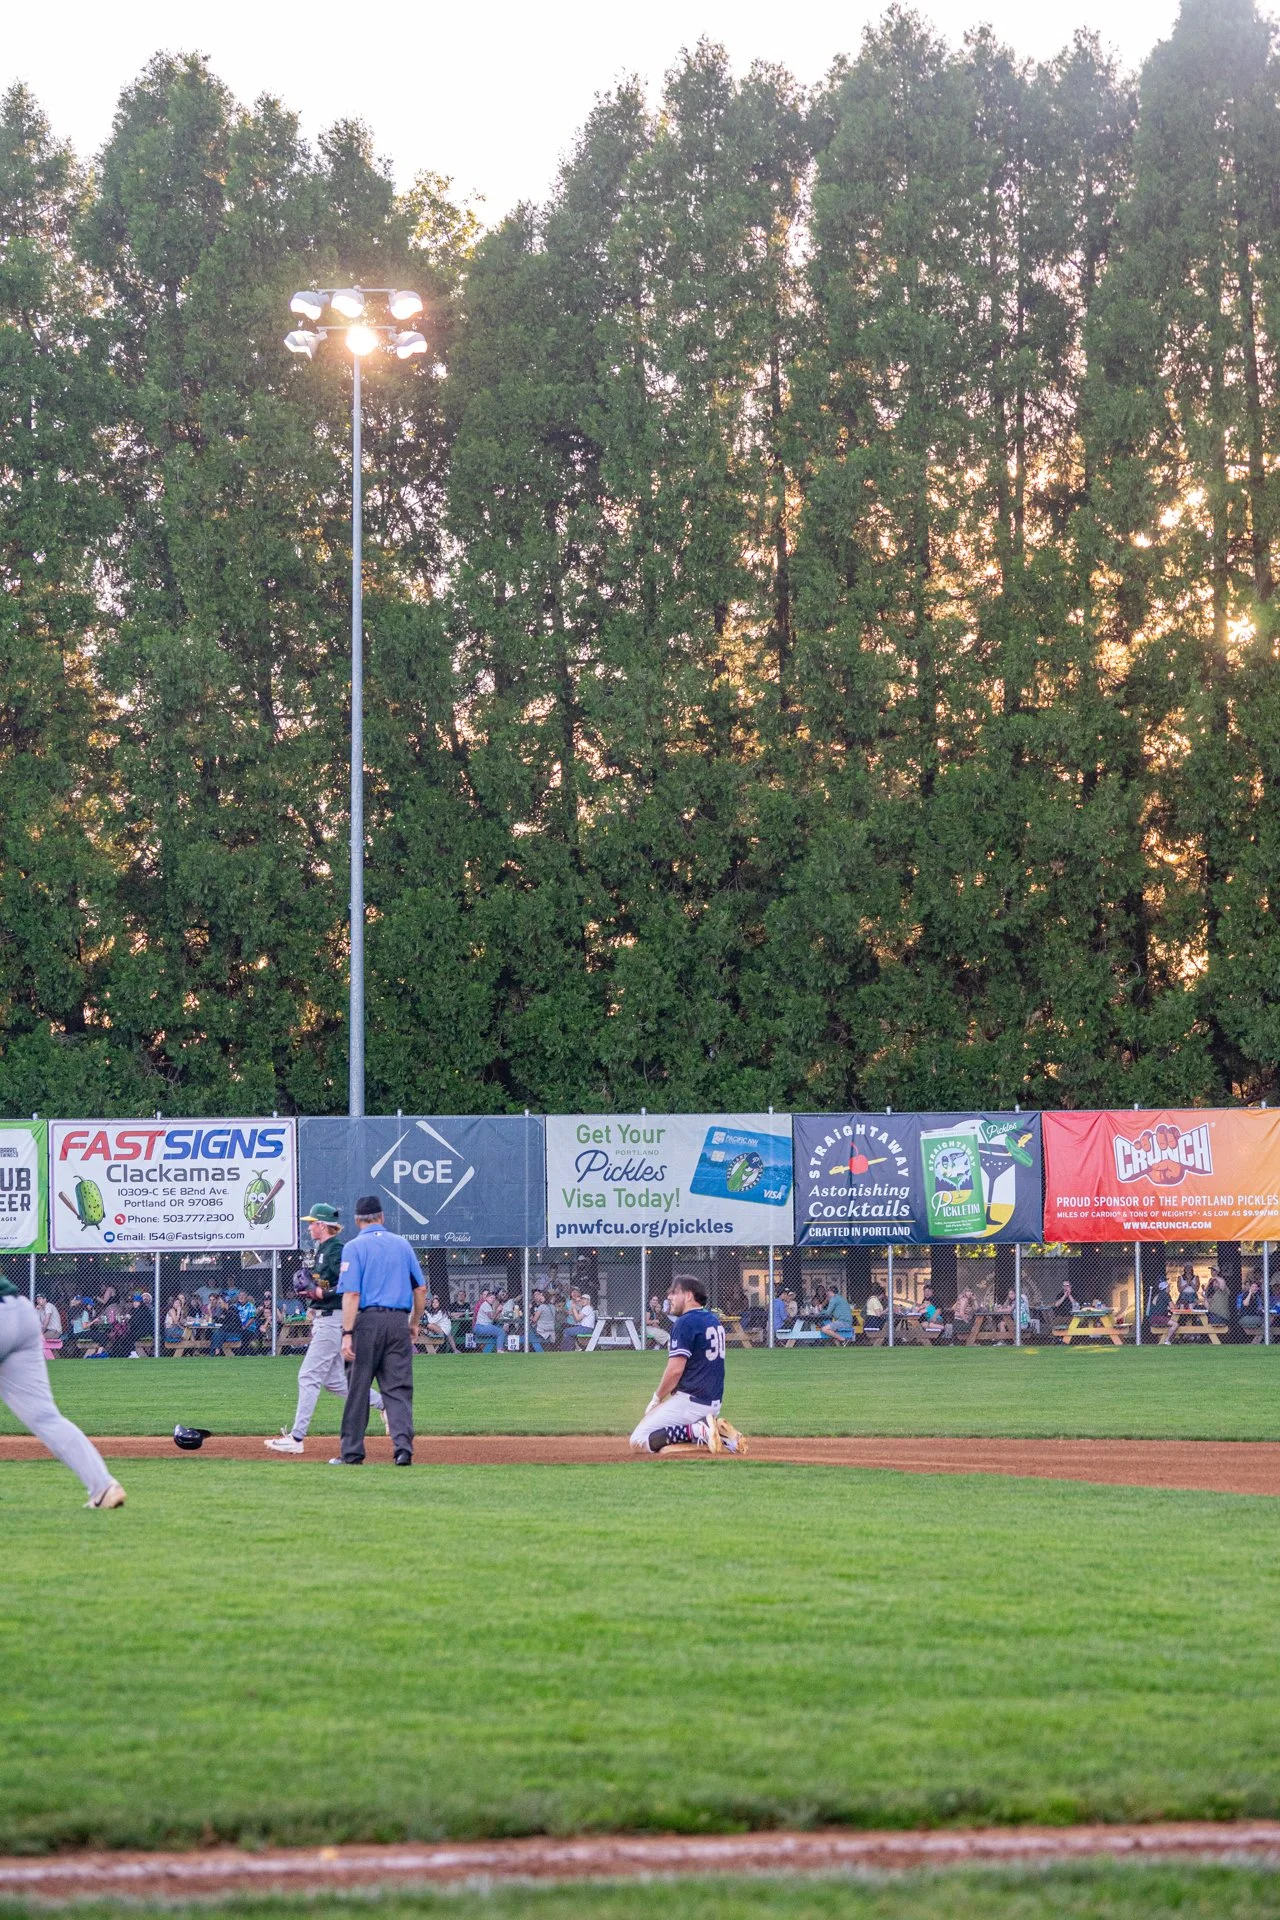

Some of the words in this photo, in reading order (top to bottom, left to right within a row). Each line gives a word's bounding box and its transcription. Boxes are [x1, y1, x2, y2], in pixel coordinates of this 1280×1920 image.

[576, 1124, 611, 1144] Get
[617, 1123, 666, 1144] Your
[986, 1122, 1017, 1138] Pickles
[59, 1128, 286, 1161] FASTSIGNS
[1117, 1124, 1213, 1181] CRUNCH
[106, 1164, 241, 1184] Clackamas
[393, 1159, 453, 1184] PGE
[575, 1150, 668, 1183] Pickles
[0, 1167, 31, 1192] UB
[117, 1188, 159, 1197] 10309-C
[162, 1187, 177, 1196] SE
[180, 1187, 206, 1196] 82nd
[209, 1187, 230, 1195] Ave.
[561, 1188, 606, 1208] Visa
[613, 1187, 680, 1212] Today!
[763, 1189, 782, 1200] VISA
[808, 1183, 910, 1200] Astonishing
[0, 1193, 31, 1212] EER
[124, 1199, 166, 1208] Portland
[169, 1199, 184, 1207] OR
[188, 1198, 223, 1207] 97086
[808, 1199, 910, 1218] Cocktails
[1056, 1196, 1091, 1208] PROUD
[1093, 1195, 1140, 1207] SPONSOR
[1142, 1195, 1156, 1207] OF
[1158, 1195, 1178, 1207] THE
[1181, 1195, 1234, 1207] PORTLAND
[1237, 1194, 1279, 1206] PICKLES
[127, 1214, 160, 1223] Phone:
[163, 1213, 235, 1223] 503.777.2300
[1123, 1221, 1212, 1229] WWW.CRUNCH.COM
[117, 1232, 146, 1241] Email:
[149, 1231, 245, 1242] 154@Fastsigns.com
[401, 1233, 419, 1241] RTNER
[420, 1233, 428, 1241] OF
[429, 1233, 441, 1241] THE
[444, 1231, 471, 1243] Pickles
[555, 1218, 734, 1238] pnwfcu.org/pickles
[808, 1227, 850, 1237] CRAFTED
[851, 1226, 860, 1237] IN
[862, 1226, 910, 1236] PORTLAND
[706, 1325, 726, 1362] 30
